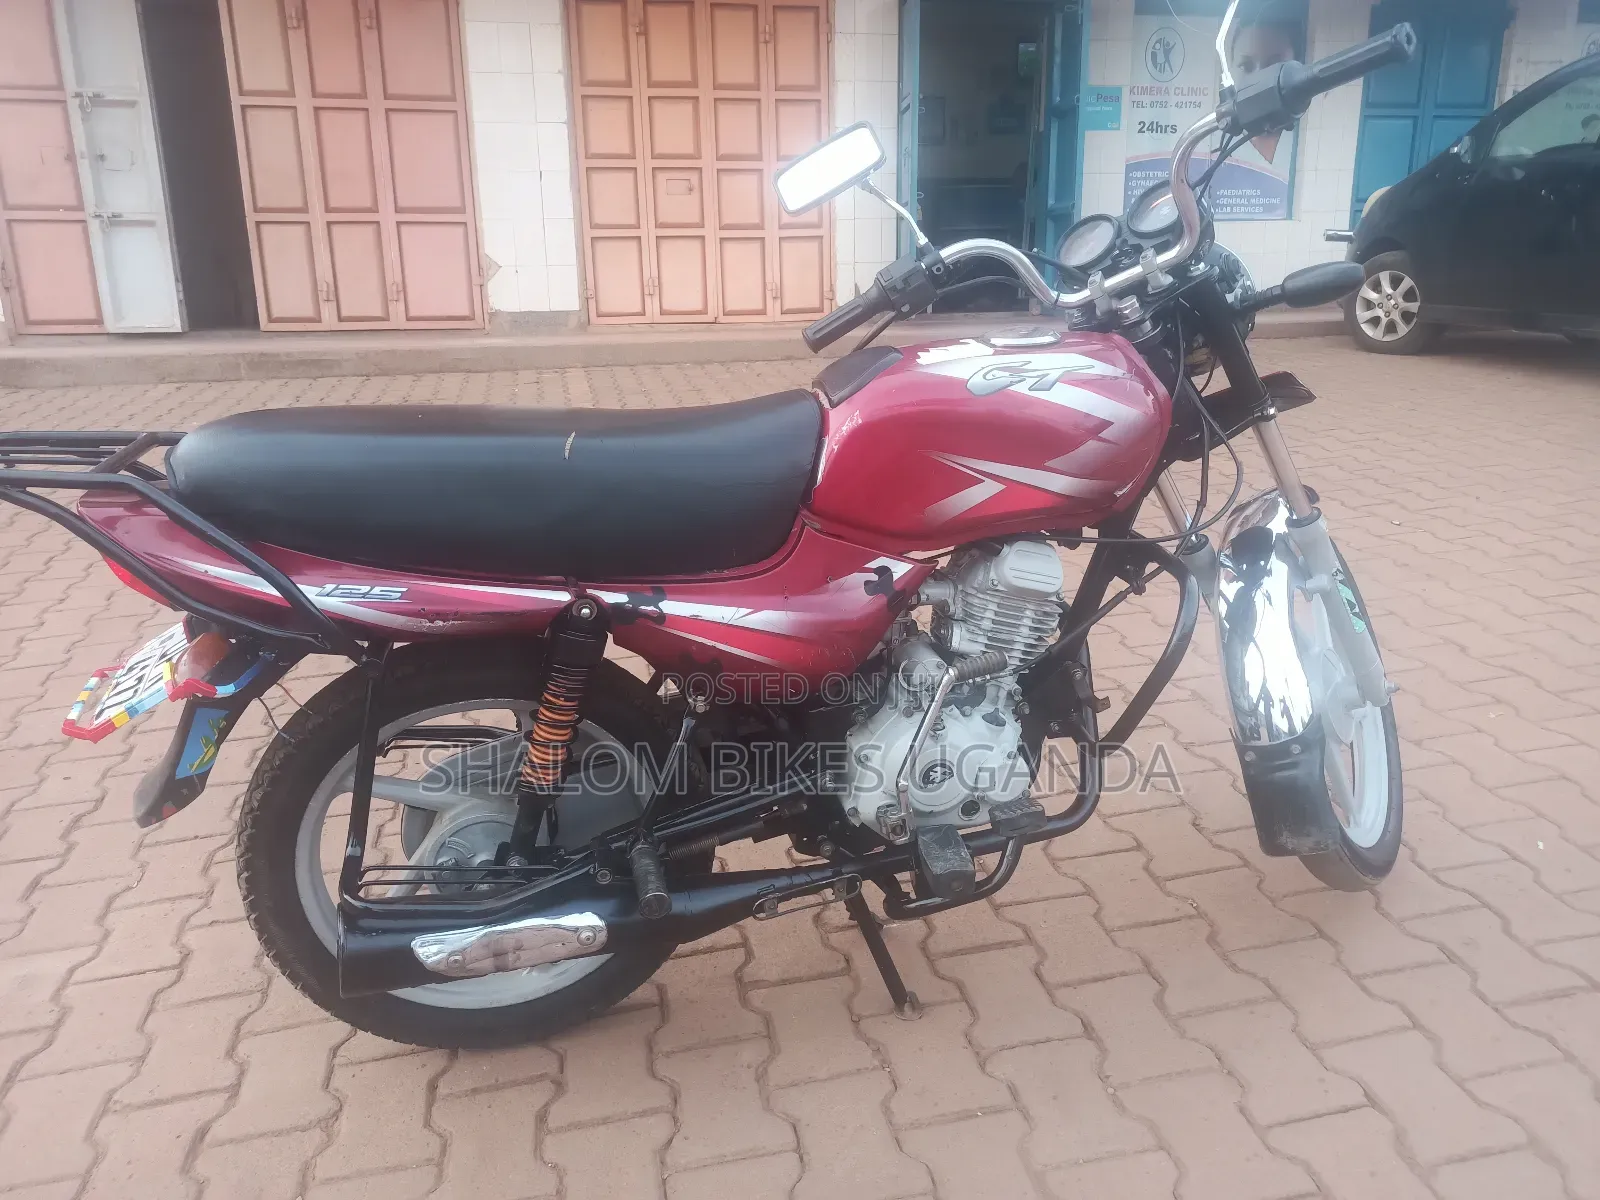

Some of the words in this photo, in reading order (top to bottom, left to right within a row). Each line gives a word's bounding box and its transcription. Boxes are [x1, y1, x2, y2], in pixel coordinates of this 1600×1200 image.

[1129, 85, 1170, 97] KIMERA
[1173, 86, 1209, 97] CLINIC
[1131, 100, 1148, 109] TEL:
[1150, 100, 1168, 109] 0752
[1174, 101, 1202, 109] 421754
[1137, 120, 1178, 134] 24hrs
[1219, 197, 1249, 205] GENERAL
[315, 583, 409, 600] 125
